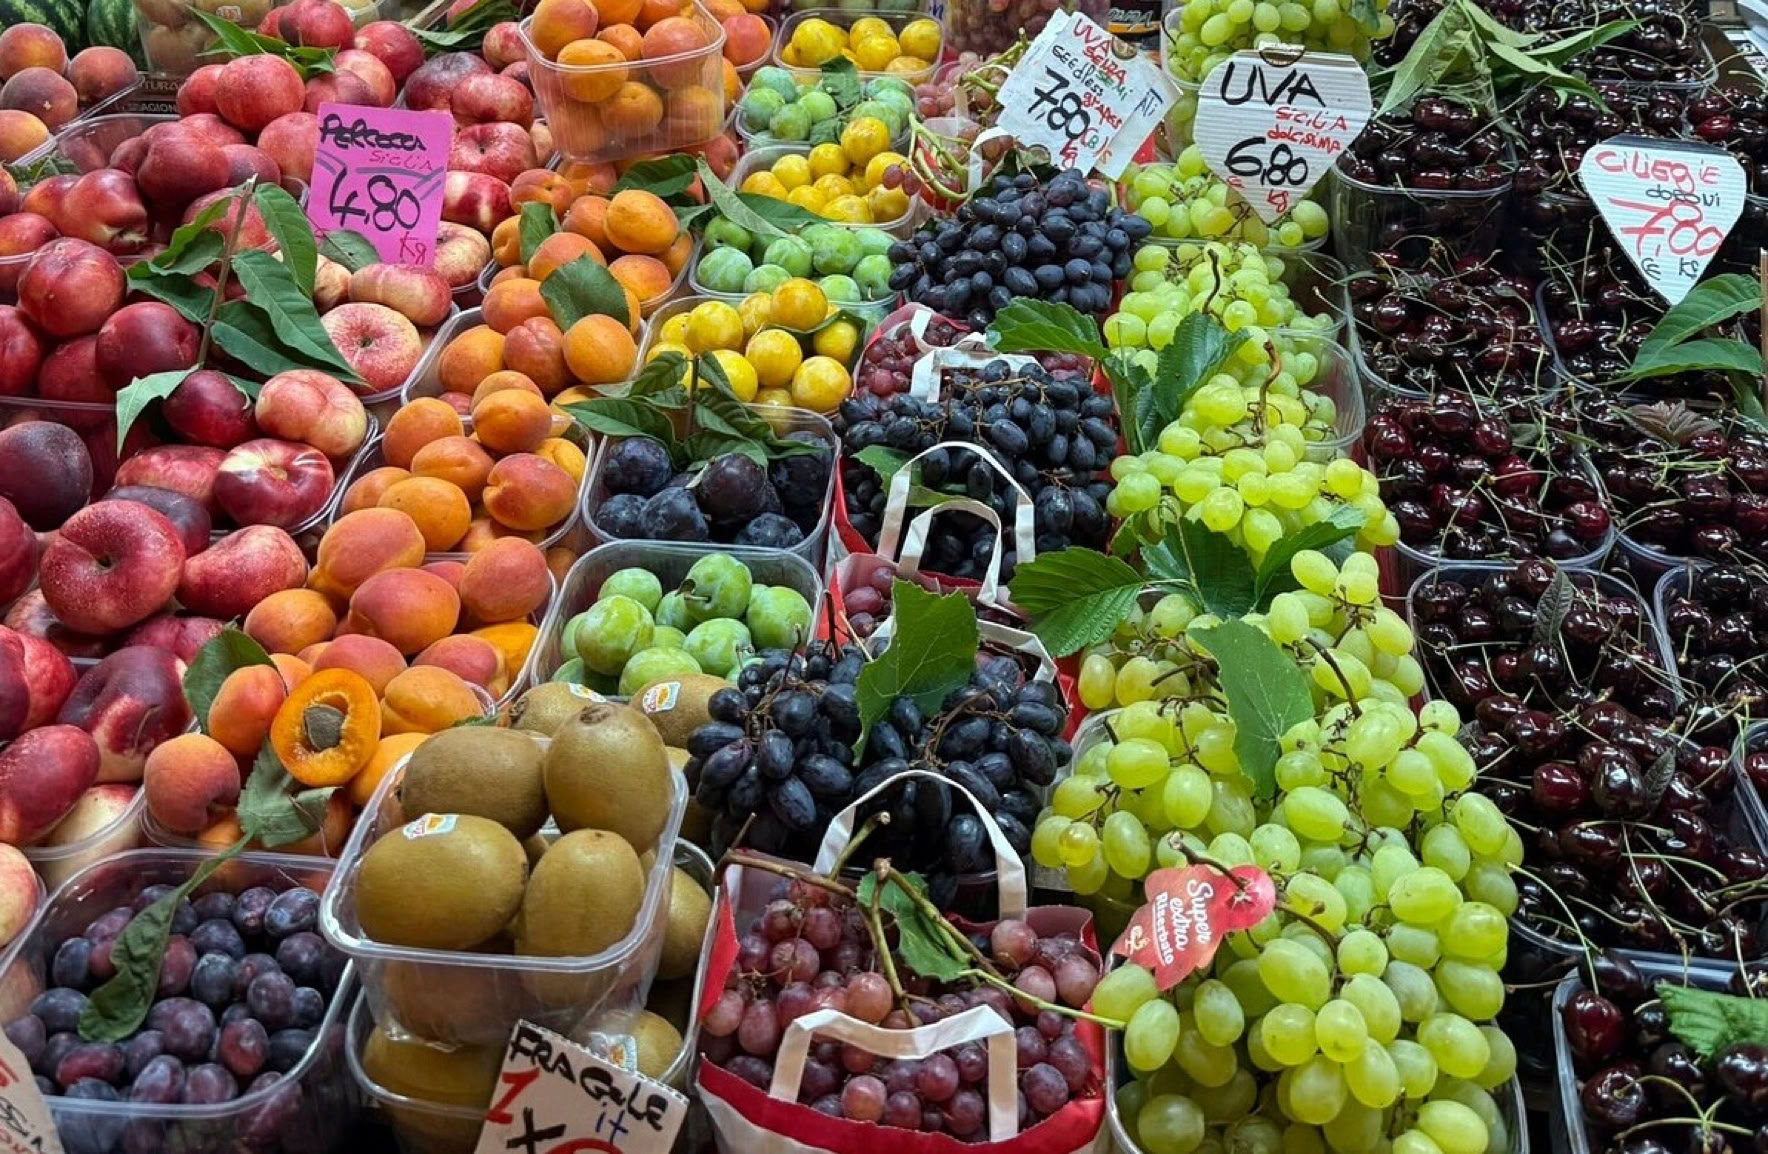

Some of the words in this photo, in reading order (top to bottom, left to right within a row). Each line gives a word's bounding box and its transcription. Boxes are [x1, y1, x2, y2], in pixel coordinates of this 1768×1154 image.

[1073, 18, 1112, 57] UVA
[1220, 62, 1327, 108] UVA
[1224, 136, 1309, 186] 6,80
[330, 167, 421, 231] 4,80
[1170, 897, 1193, 951] extra
[1187, 879, 1214, 944] Super
